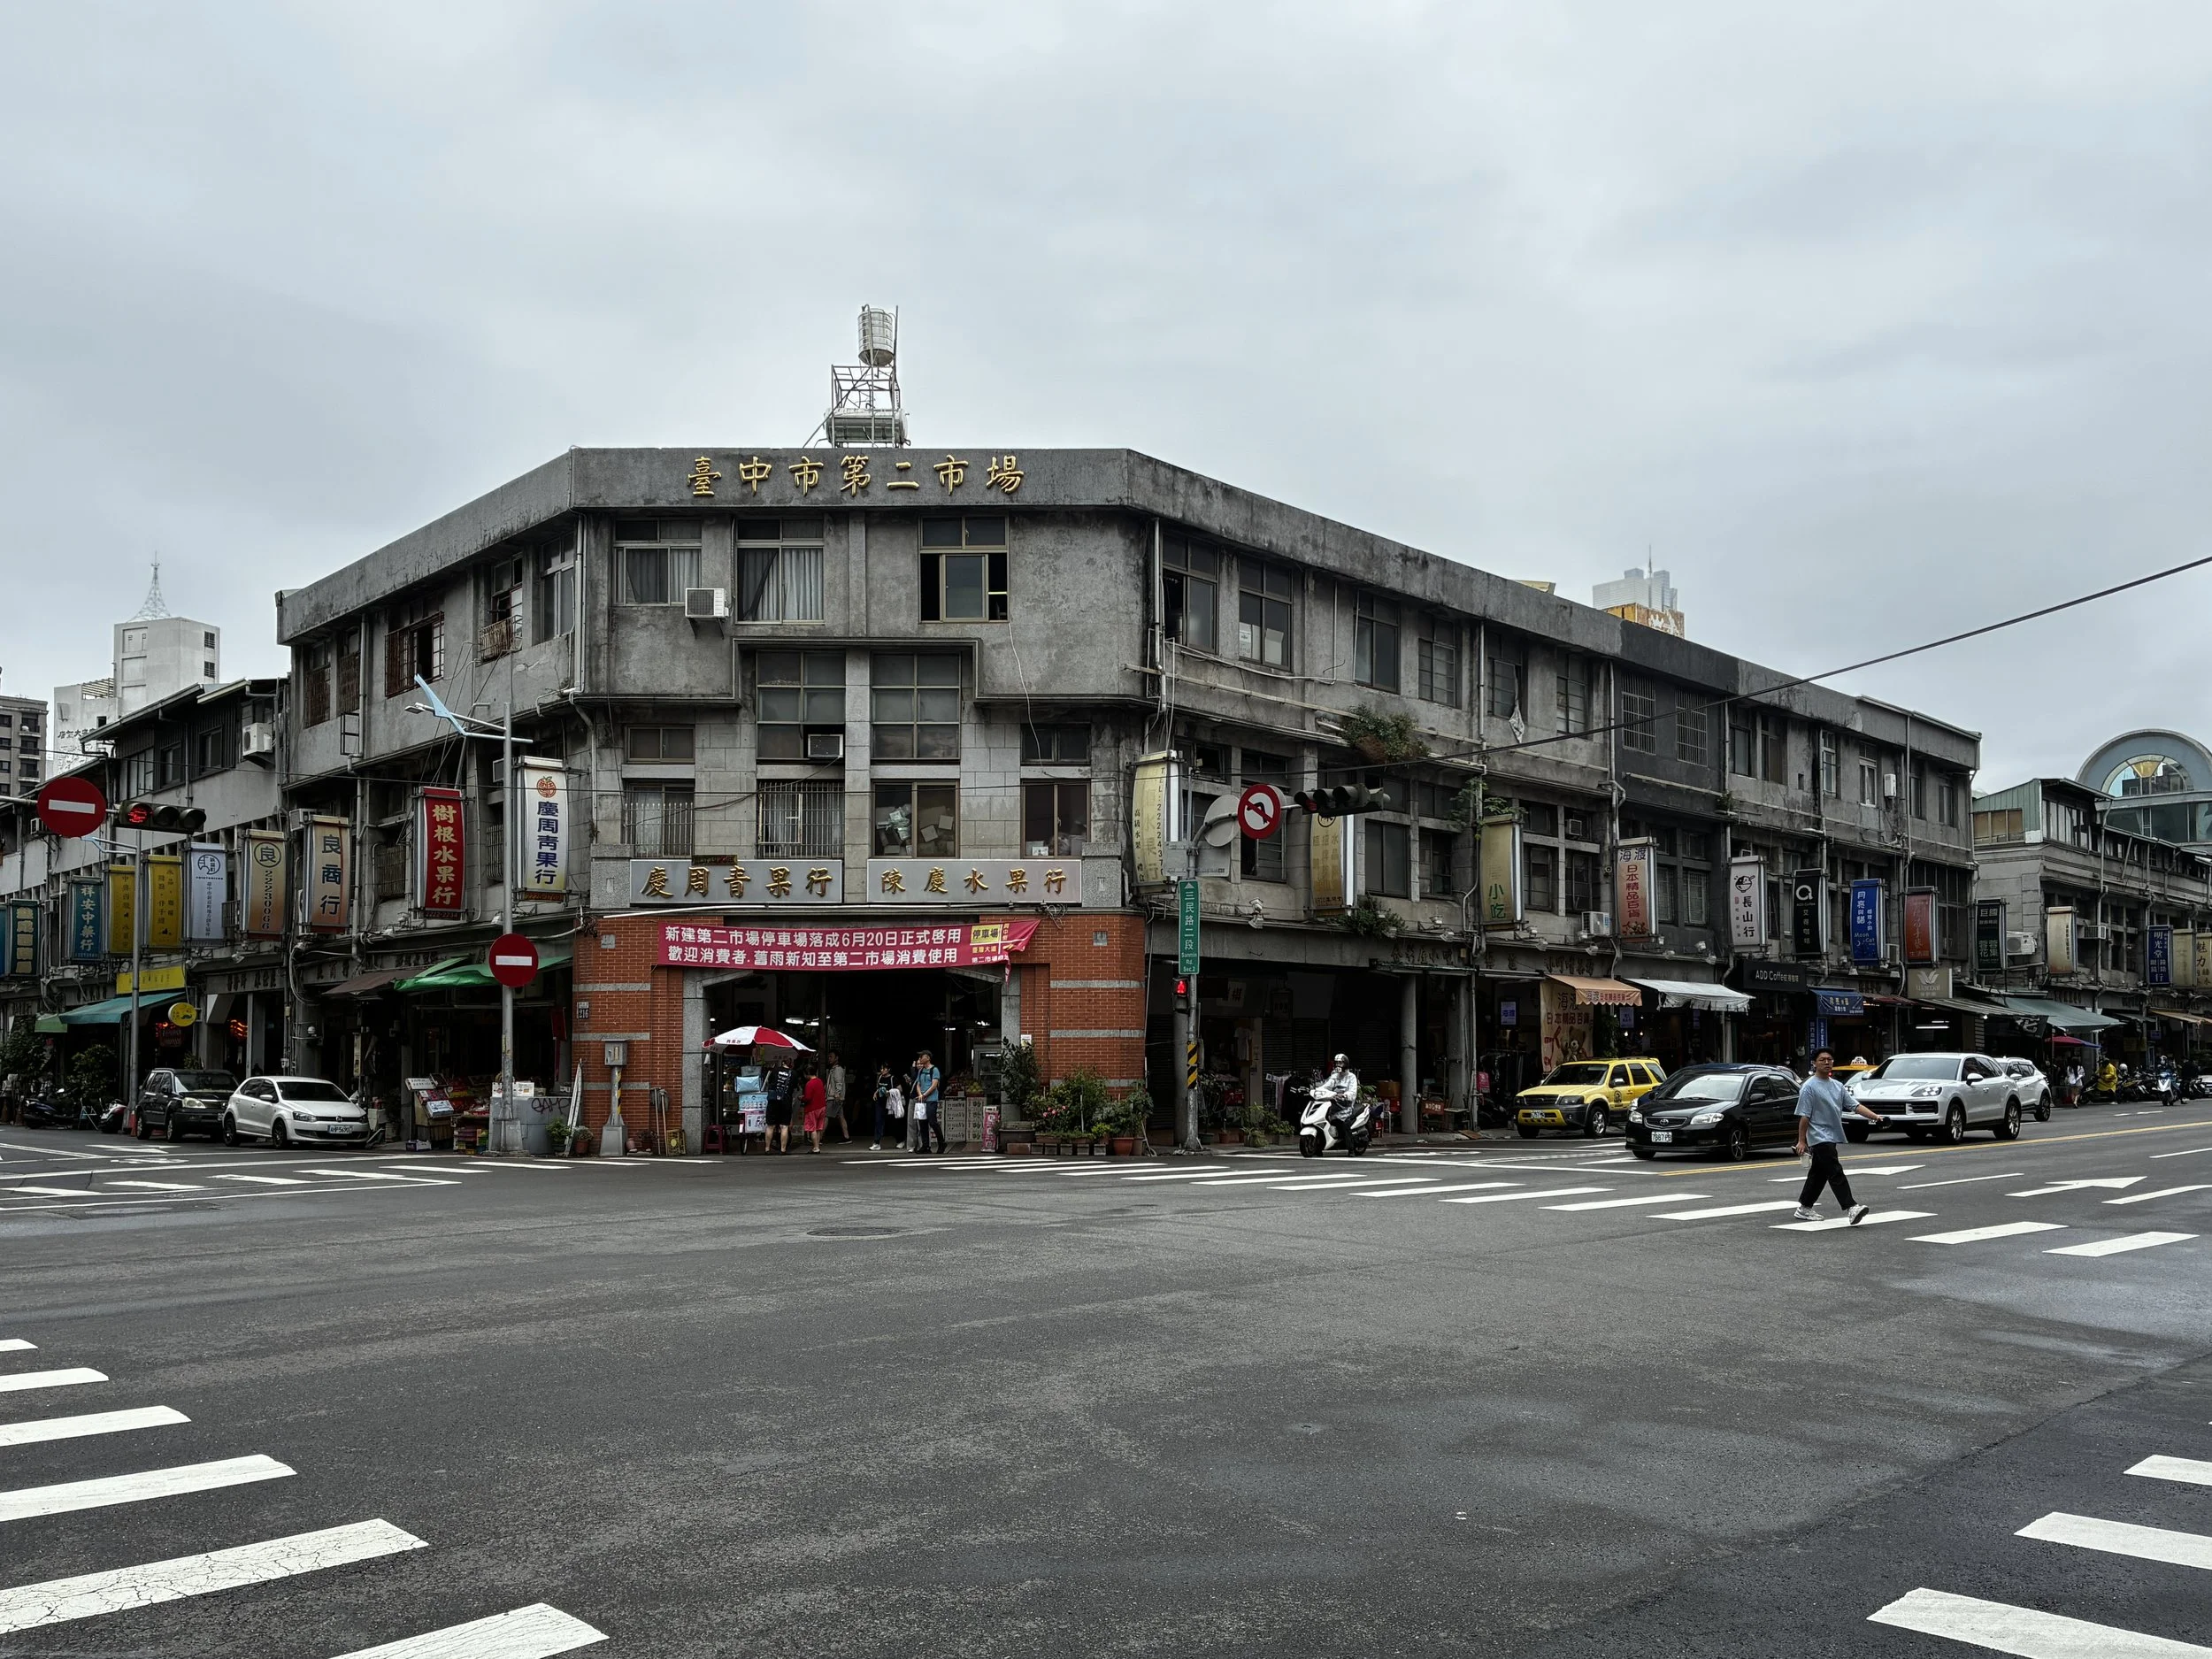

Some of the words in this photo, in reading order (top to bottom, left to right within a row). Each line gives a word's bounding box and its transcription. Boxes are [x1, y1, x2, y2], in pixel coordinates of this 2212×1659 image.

[687, 455, 1025, 497] 臺中市第二市場
[259, 846, 276, 864] 良
[432, 804, 457, 905] 樹根水果行
[534, 801, 559, 885] 慶周青果行
[1619, 847, 1647, 862] 海渡
[320, 834, 342, 915] 良商行
[640, 865, 833, 898] 慶周青果行
[881, 866, 1067, 895] 陳慶水果行
[1625, 864, 1640, 918] 日本精品百貨
[1489, 883, 1506, 918] 小吃
[1742, 895, 1755, 938] 長山行
[973, 928, 999, 940] 停車場
[1184, 891, 1194, 950] 三民路二段
[1755, 970, 1768, 979] ADD
[579, 1009, 589, 1018] 216
[1547, 1012, 1590, 1025] 日本精品百貨
